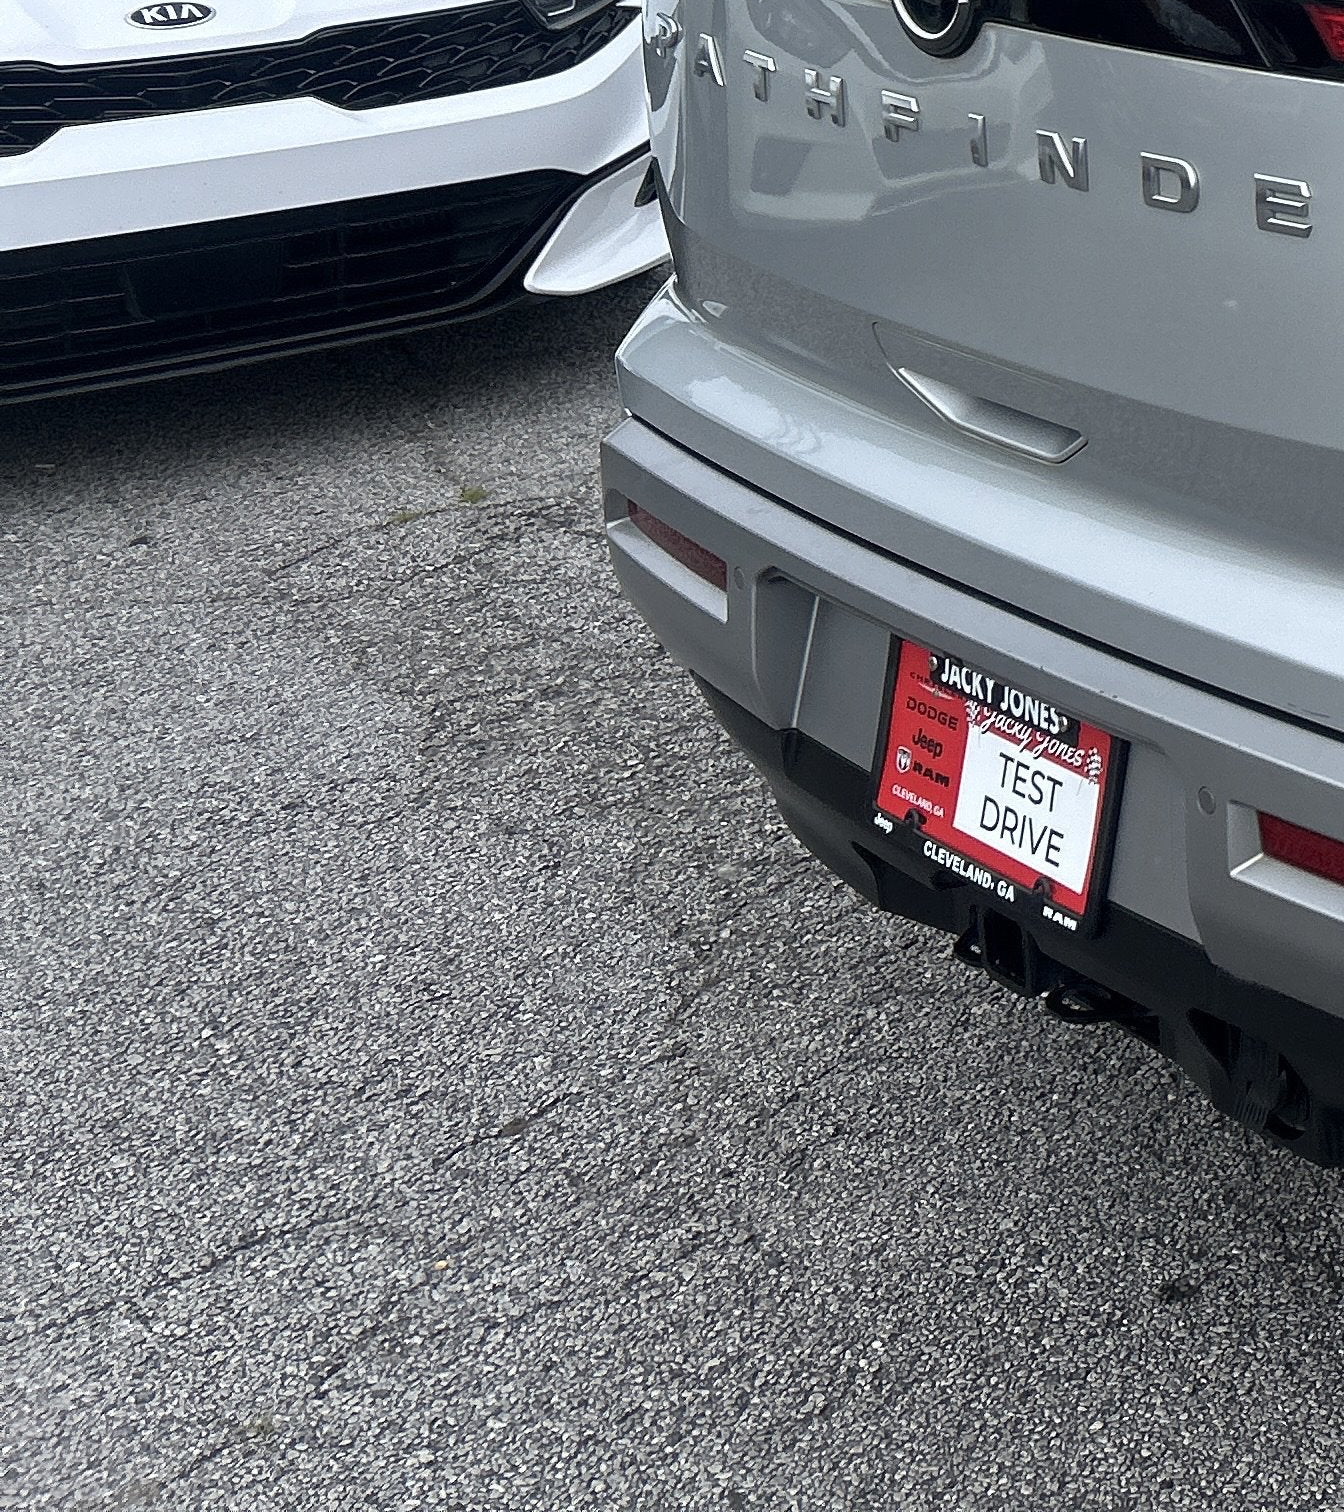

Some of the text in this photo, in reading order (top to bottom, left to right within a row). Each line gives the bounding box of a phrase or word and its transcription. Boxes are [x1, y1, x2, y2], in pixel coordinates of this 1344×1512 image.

[140, 4, 204, 23] KIA
[906, 696, 958, 731] DODGE
[941, 658, 996, 703] JACKY
[1000, 686, 1060, 735] JONES
[912, 728, 943, 759] Jeep
[912, 760, 950, 788] RAM
[999, 752, 1063, 812] TEST
[892, 784, 945, 818] CLEVELAND, GA
[874, 812, 894, 834] Jeep
[980, 794, 1064, 868] DRIVE
[923, 841, 1015, 902] CLEVELAND, GA
[1042, 905, 1078, 931] RAM
